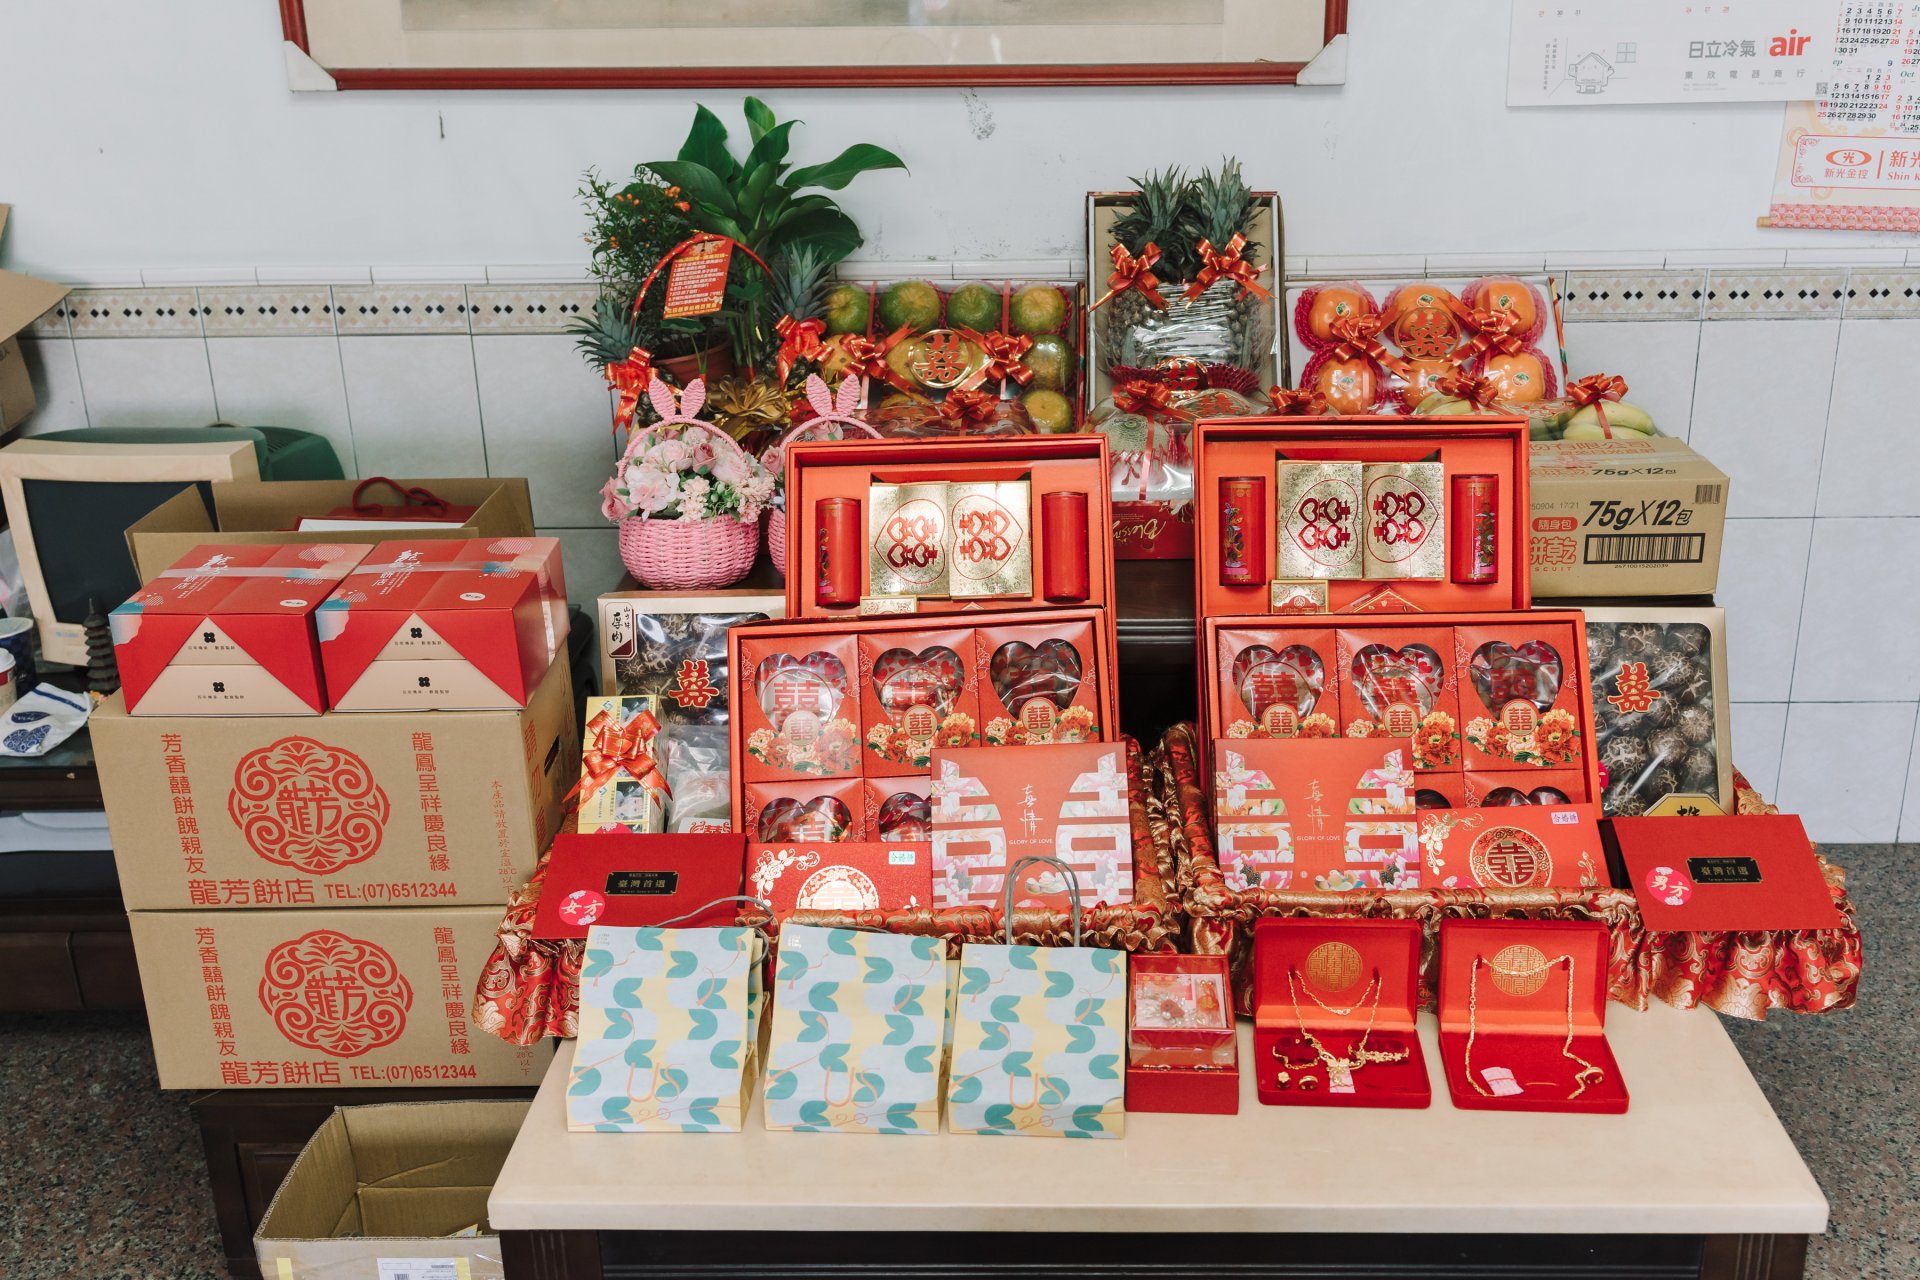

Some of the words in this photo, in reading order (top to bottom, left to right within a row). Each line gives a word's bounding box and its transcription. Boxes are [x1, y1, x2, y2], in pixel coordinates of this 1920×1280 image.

[1689, 40, 1757, 59] 日立冷氣
[1769, 28, 1812, 57] air
[1843, 152, 1855, 164] 光
[1824, 168, 1869, 180] 新光金控
[1887, 172, 1910, 181] Shin
[1537, 519, 1572, 531] 隨身包
[411, 731, 452, 872] 龍鳳呈祥慶良緣
[189, 878, 316, 906] 龍芳餅店
[326, 881, 458, 902] TEL:(07)6512344
[1649, 875, 1692, 898] 男方
[561, 899, 604, 916] 女方
[433, 926, 472, 1056] 龍鳳呈祥慶良緣
[220, 1061, 341, 1086] 龍芳餅店
[349, 1064, 478, 1083] TEL:(07)6512344
